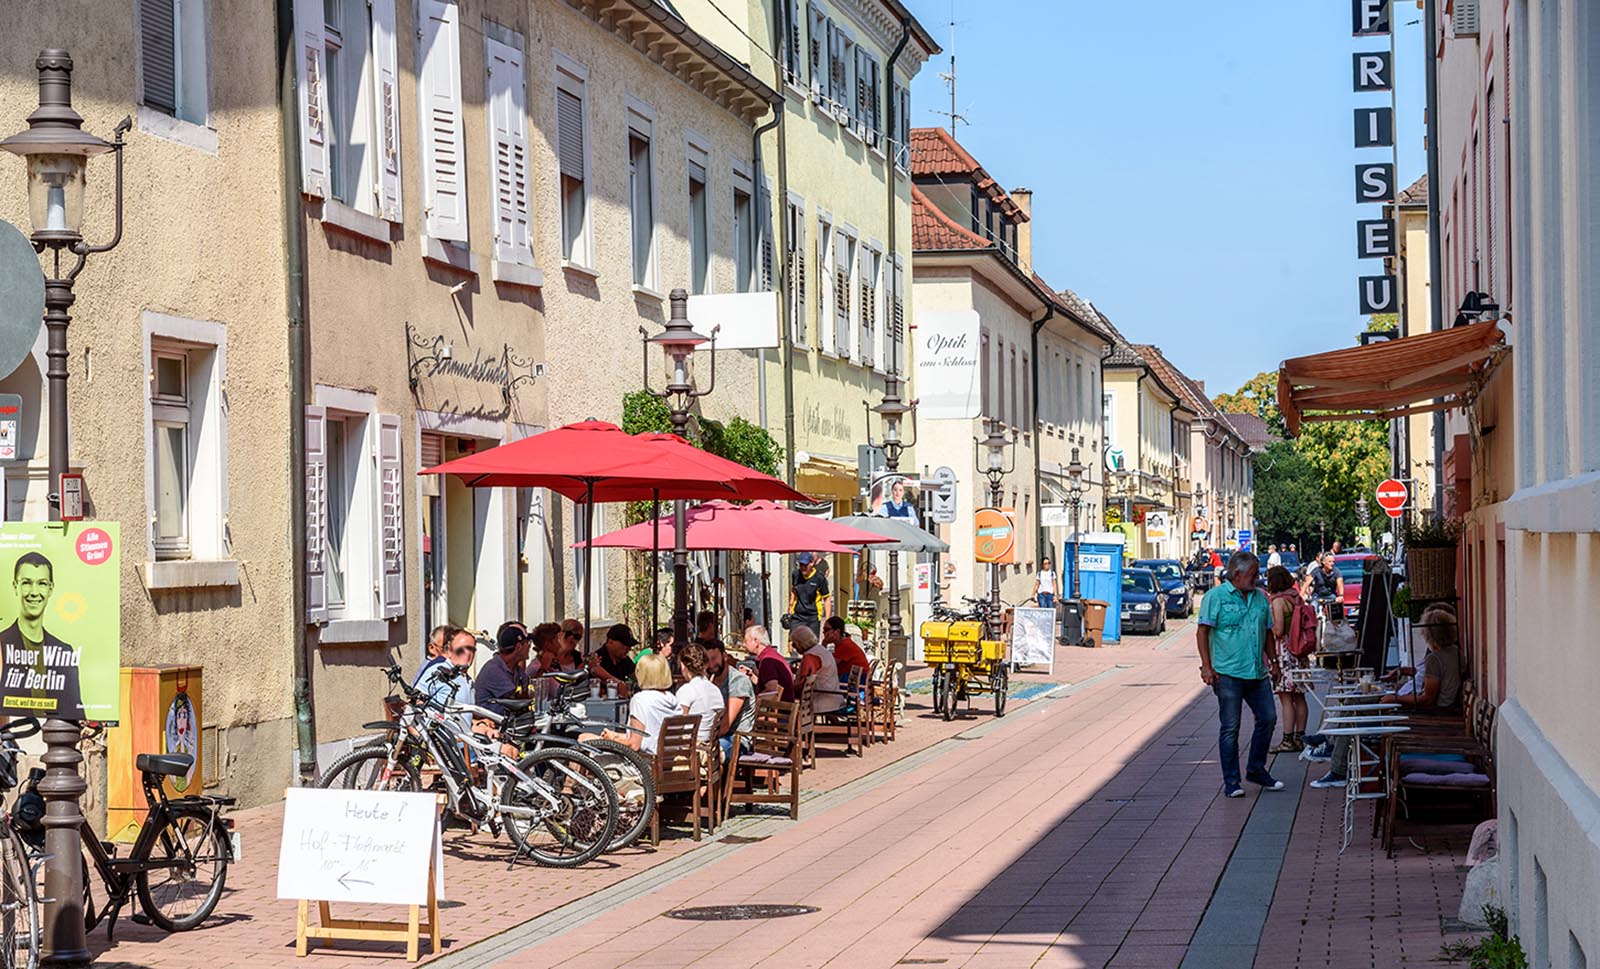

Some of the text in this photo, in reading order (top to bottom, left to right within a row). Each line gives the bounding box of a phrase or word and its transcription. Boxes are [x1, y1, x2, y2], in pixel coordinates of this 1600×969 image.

[926, 332, 967, 355] Optik
[86, 532, 99, 542] Alle
[6, 644, 81, 667] Neuer Wind
[4, 666, 65, 690] für Berlin
[344, 800, 389, 820] Heute
